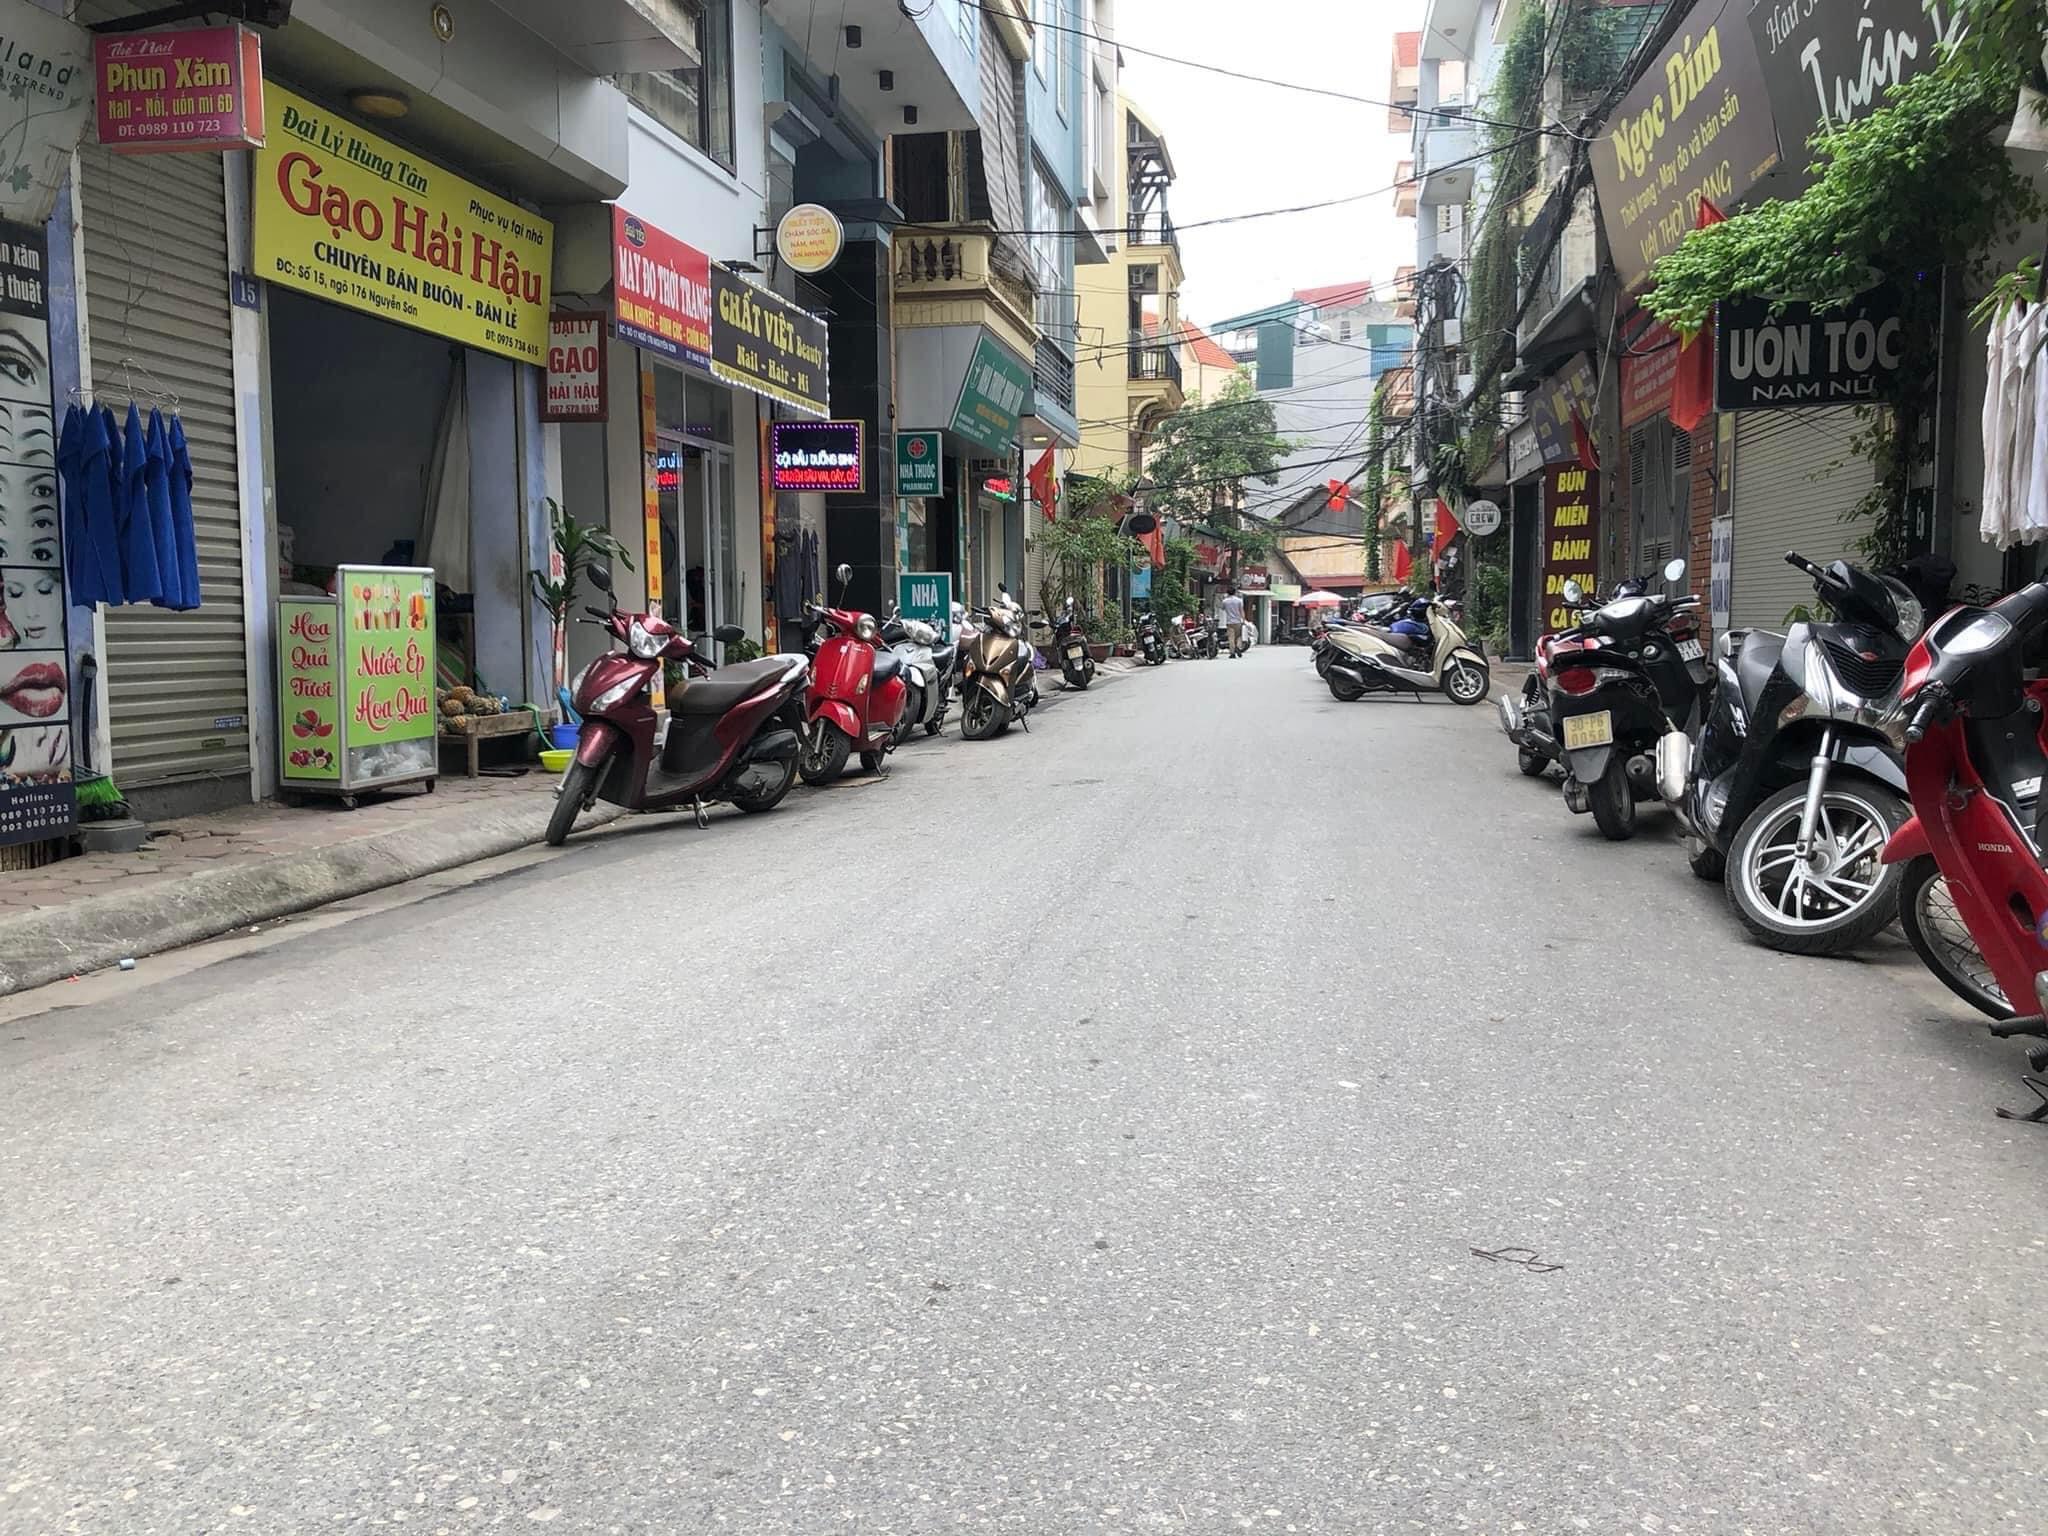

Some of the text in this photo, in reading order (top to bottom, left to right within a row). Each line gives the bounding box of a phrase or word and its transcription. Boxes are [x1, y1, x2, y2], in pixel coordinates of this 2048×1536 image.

[106, 57, 231, 93] Phun Xăm
[108, 99, 132, 119] Nail
[217, 94, 233, 113] 6D
[118, 119, 221, 137] ĐT: 0989 110 723
[1611, 94, 1666, 183] Ngọc
[1699, 113, 1720, 148] bán
[282, 105, 429, 194] Đại Lý Hùng Tân
[277, 152, 542, 307] Gạo Hải Hậu
[469, 199, 544, 246] Phục vụ tại nhà
[13, 243, 40, 271] xăm
[7, 273, 43, 309] thuật
[240, 280, 256, 304] 15
[276, 256, 296, 276] ĐC:
[298, 264, 311, 280] Số
[313, 271, 328, 288] 15,
[351, 282, 367, 301] 176
[368, 290, 402, 312] Nguyễn
[402, 301, 418, 318] Sơn
[313, 240, 381, 283] CHUYÊN
[386, 268, 418, 296] BÁN
[422, 279, 464, 311] BUÔN
[475, 300, 502, 325] BÁN
[505, 307, 517, 330] LẺ
[618, 245, 708, 324] MAY ĐO THỜI TRANG
[552, 319, 574, 337] ĐẠI
[719, 287, 760, 338] CHẤT
[763, 311, 794, 356] VIỆT
[796, 335, 822, 370] Beauty
[1823, 307, 1900, 373] TÓC
[497, 335, 514, 348] 0975
[527, 343, 539, 356] 615
[549, 346, 598, 379] GẠO
[737, 343, 759, 372] Nail
[768, 358, 789, 385] Hair
[549, 381, 600, 401] HẢI HẬU
[1752, 374, 1877, 401] NAM NỮ
[900, 458, 936, 479] NHÀ THUỐC
[1557, 466, 1587, 493] BÚN
[1554, 496, 1589, 527] MIẾN
[1552, 535, 1591, 561] BÁNH
[911, 578, 939, 607] NHÀ
[289, 612, 331, 643] Hoa
[291, 646, 328, 669] Quả
[357, 637, 426, 680] Nước Ép
[290, 677, 333, 698] Tươi
[355, 684, 429, 732] Hoa Quả
[11, 793, 54, 805] Hotline:
[49, 803, 69, 814] 723
[26, 818, 46, 828] 000
[1977, 842, 2013, 853] HONDA
